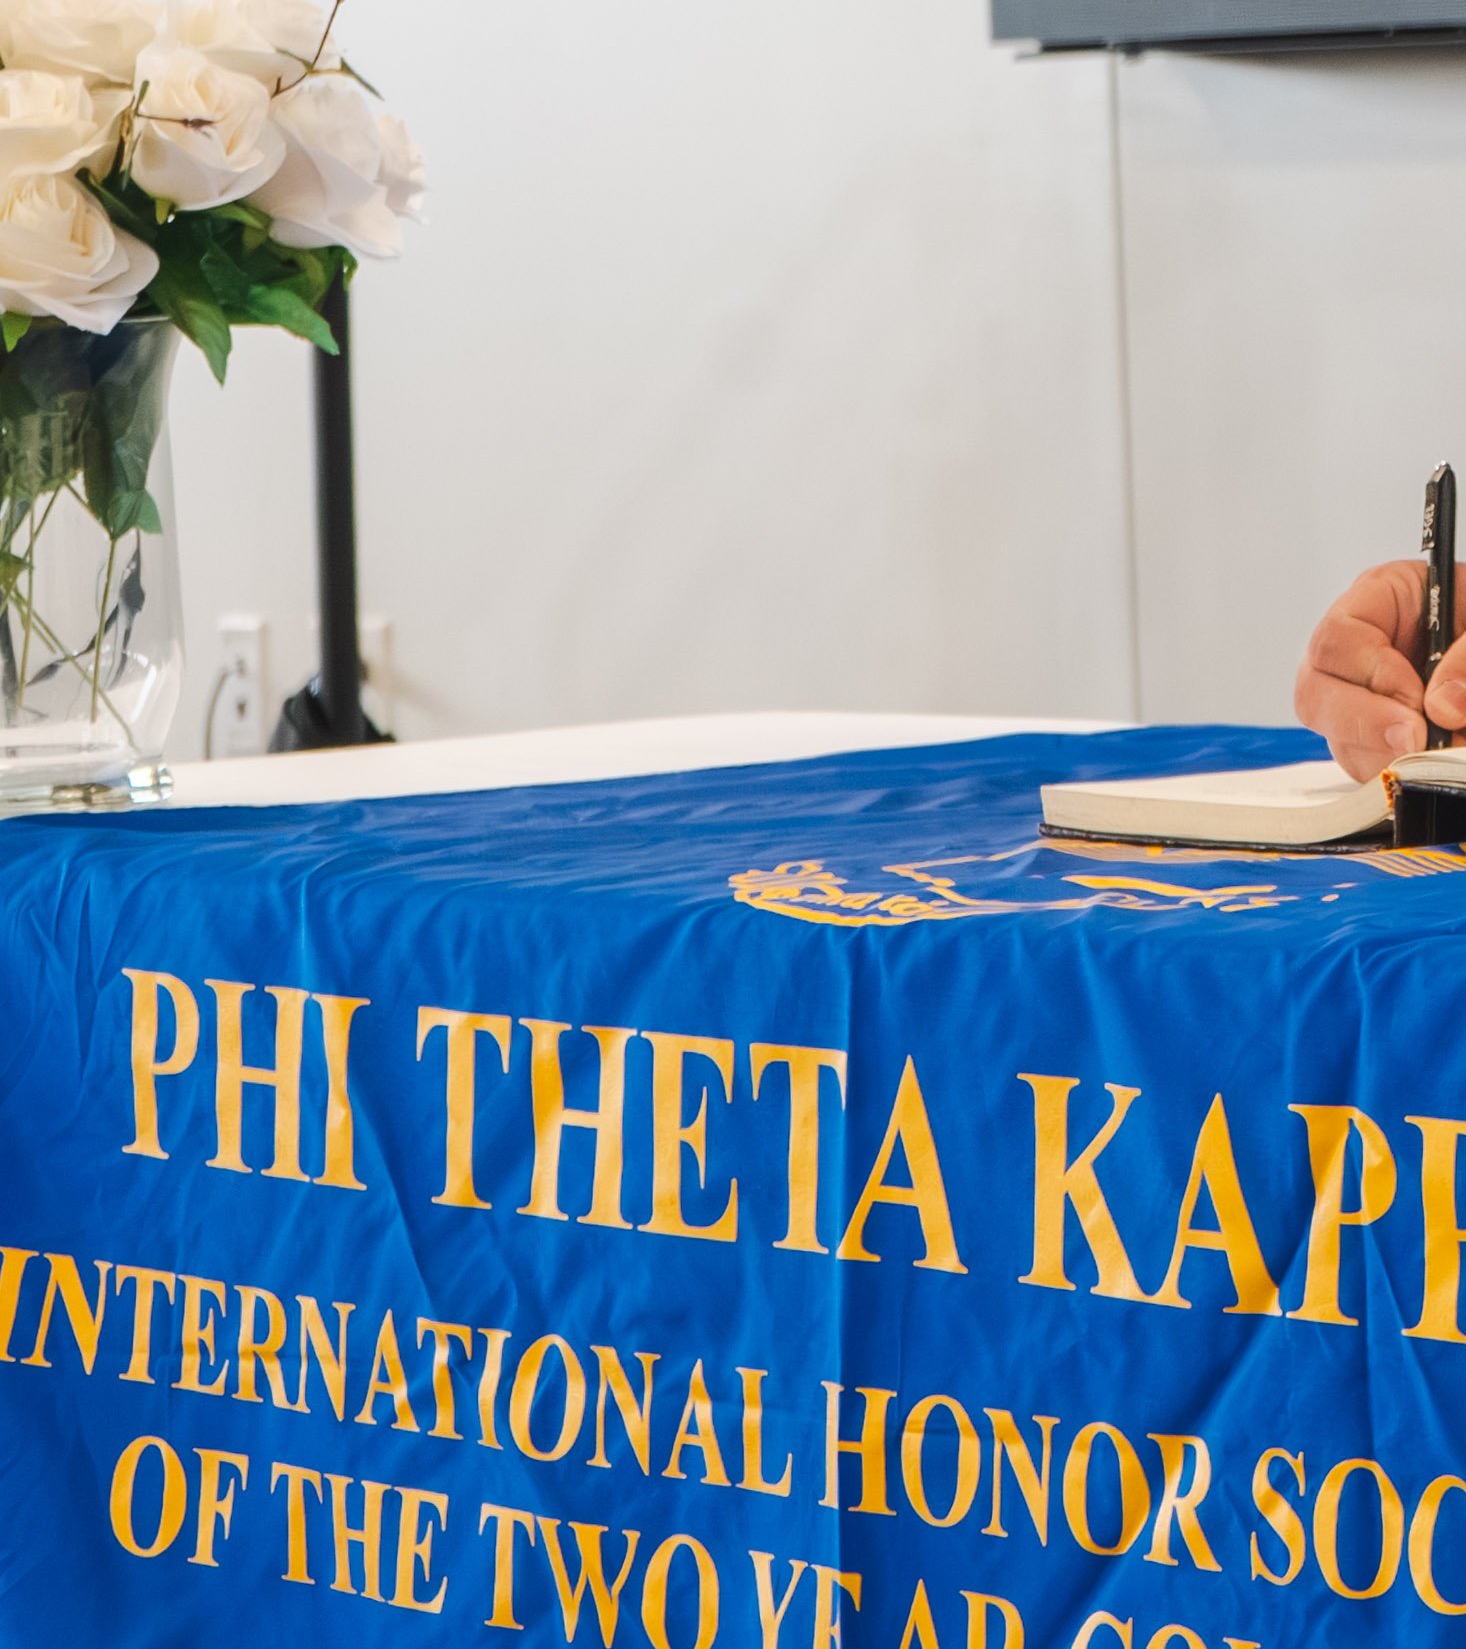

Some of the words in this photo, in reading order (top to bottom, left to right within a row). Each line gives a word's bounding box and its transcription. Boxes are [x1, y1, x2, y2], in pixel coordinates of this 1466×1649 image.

[122, 968, 371, 1191] PHI
[416, 1006, 969, 1275] THETA
[0, 1246, 793, 1497] INTERNATIONAL
[820, 1381, 1223, 1573] HONOR
[109, 1435, 250, 1568] OF
[271, 1461, 449, 1614] THE
[479, 1503, 720, 1649] TWO
